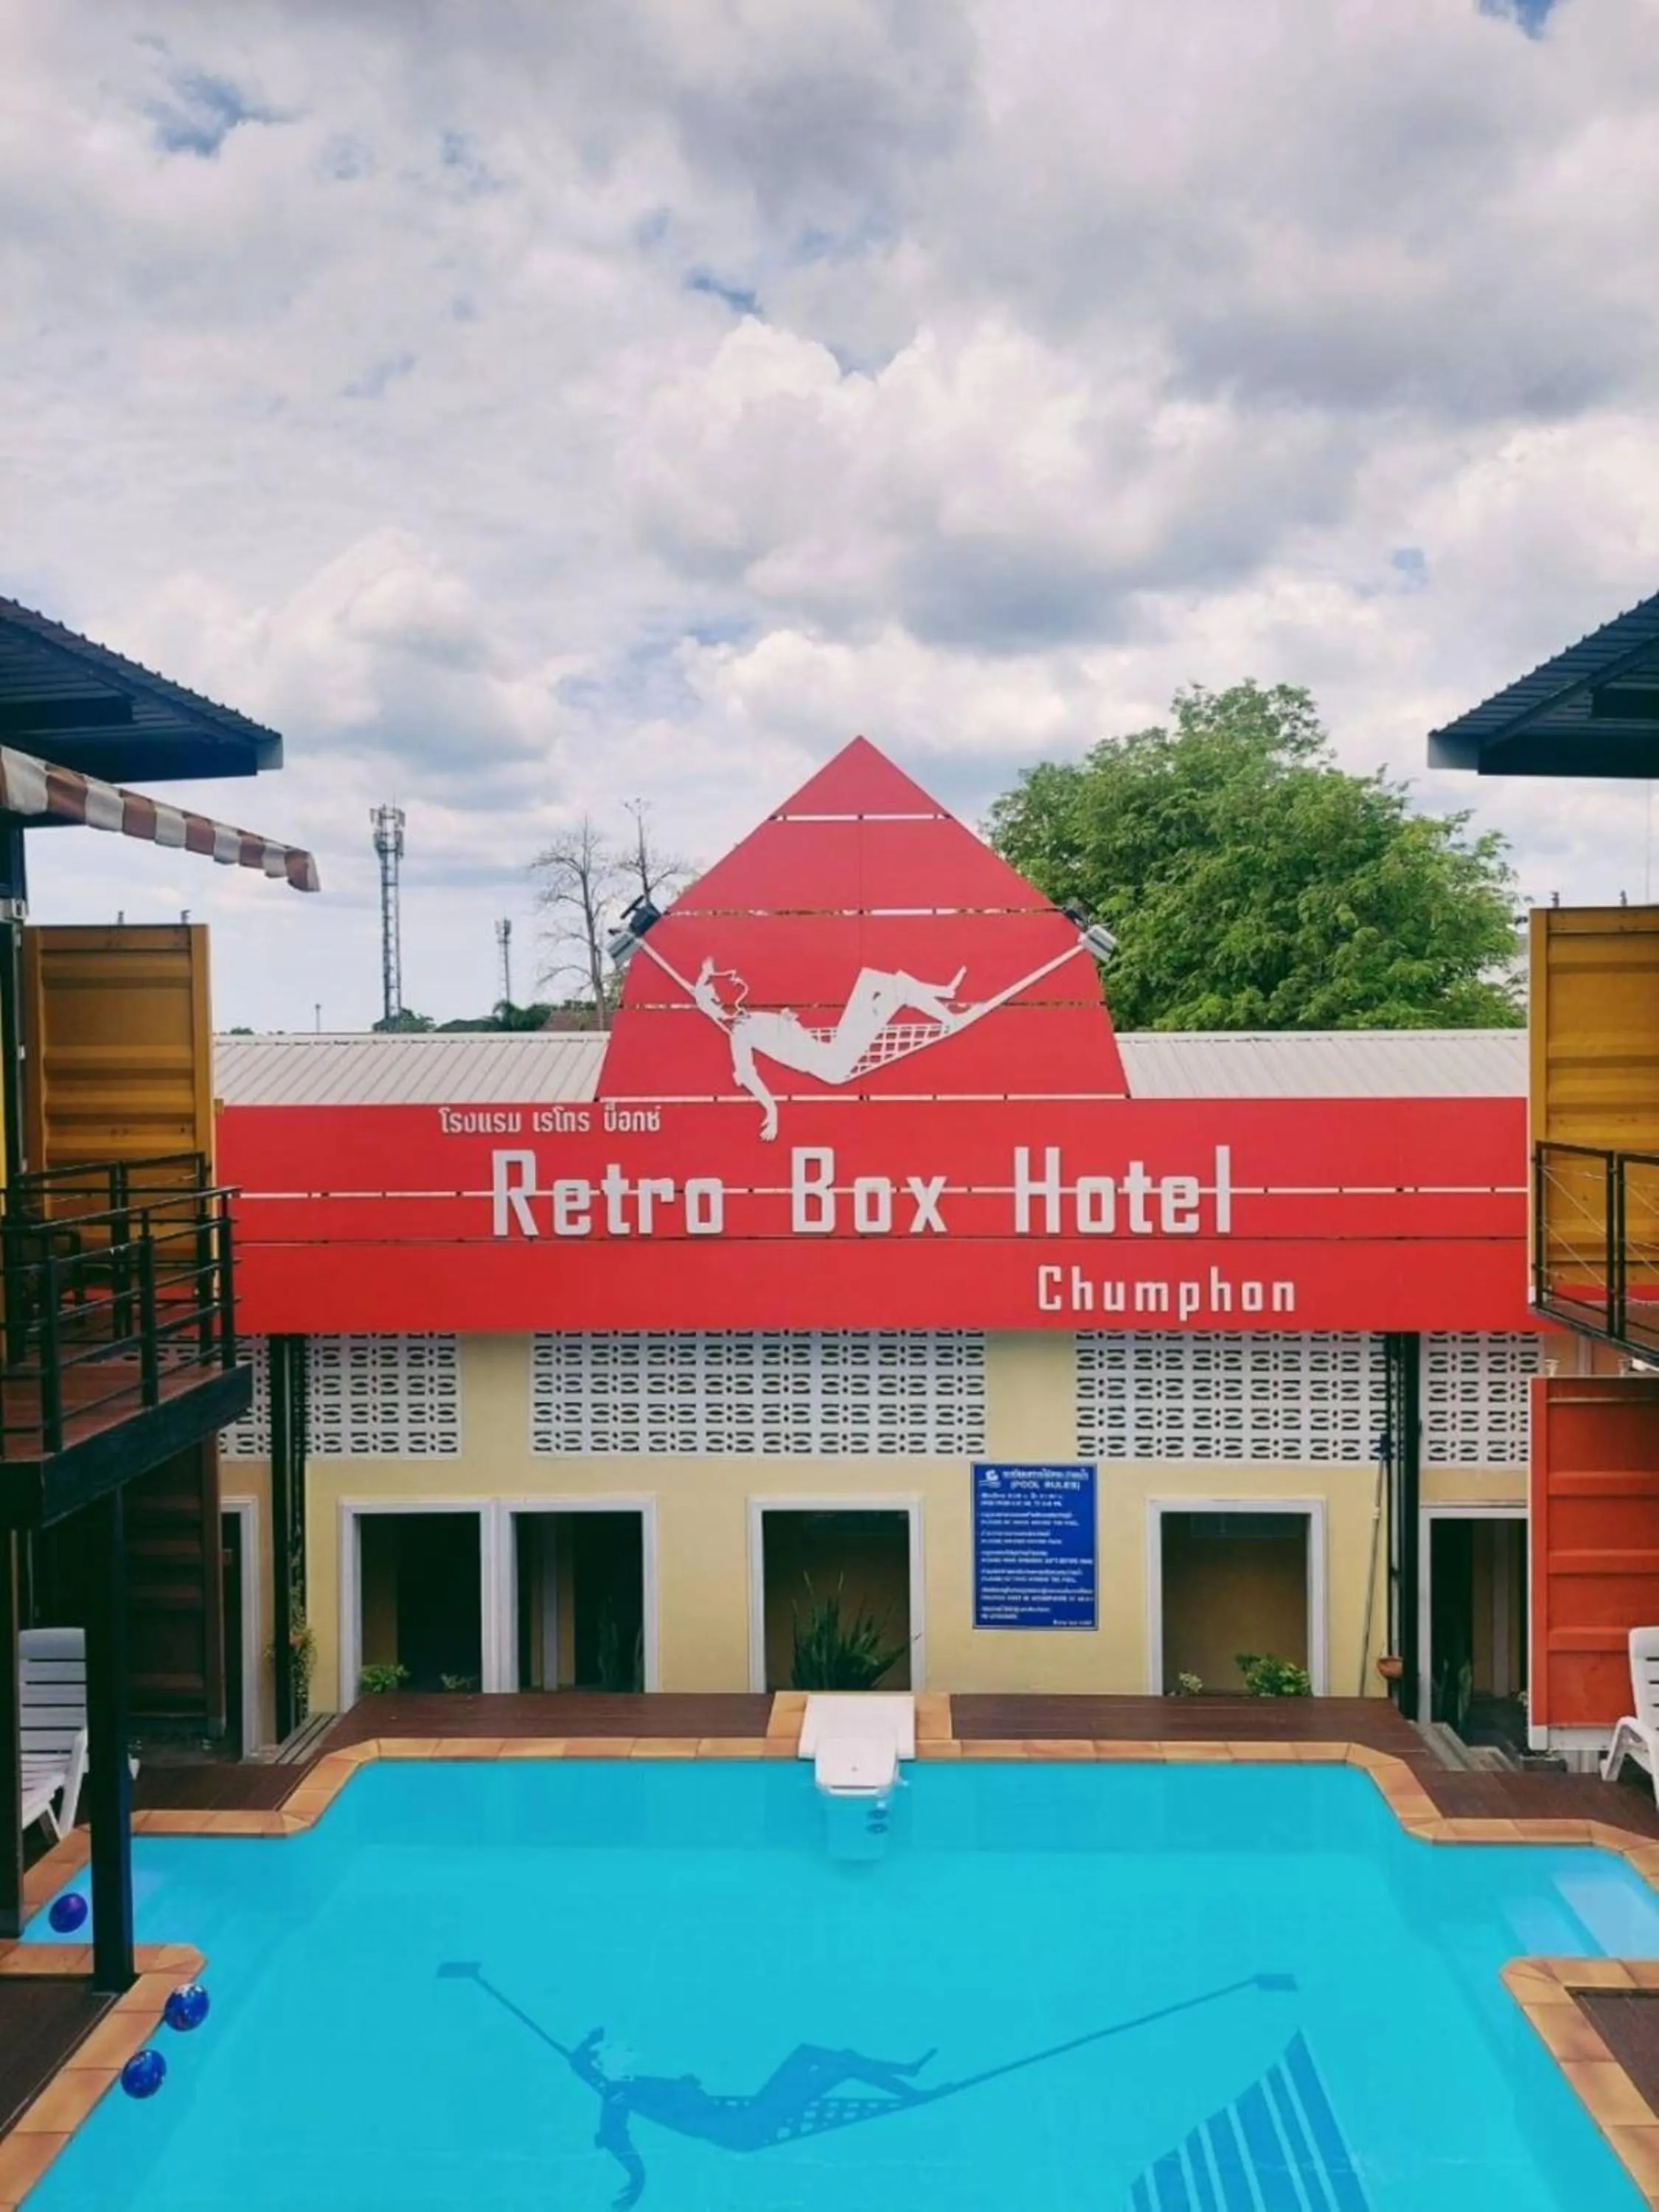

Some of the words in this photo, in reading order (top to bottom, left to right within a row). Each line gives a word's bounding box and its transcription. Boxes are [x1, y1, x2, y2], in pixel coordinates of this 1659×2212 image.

[438, 1107, 521, 1133] โรงแรม
[492, 1150, 724, 1237] Retro
[791, 1147, 947, 1233] Box
[1014, 1145, 1231, 1234] Hotel
[1038, 1265, 1295, 1321] Chumphon
